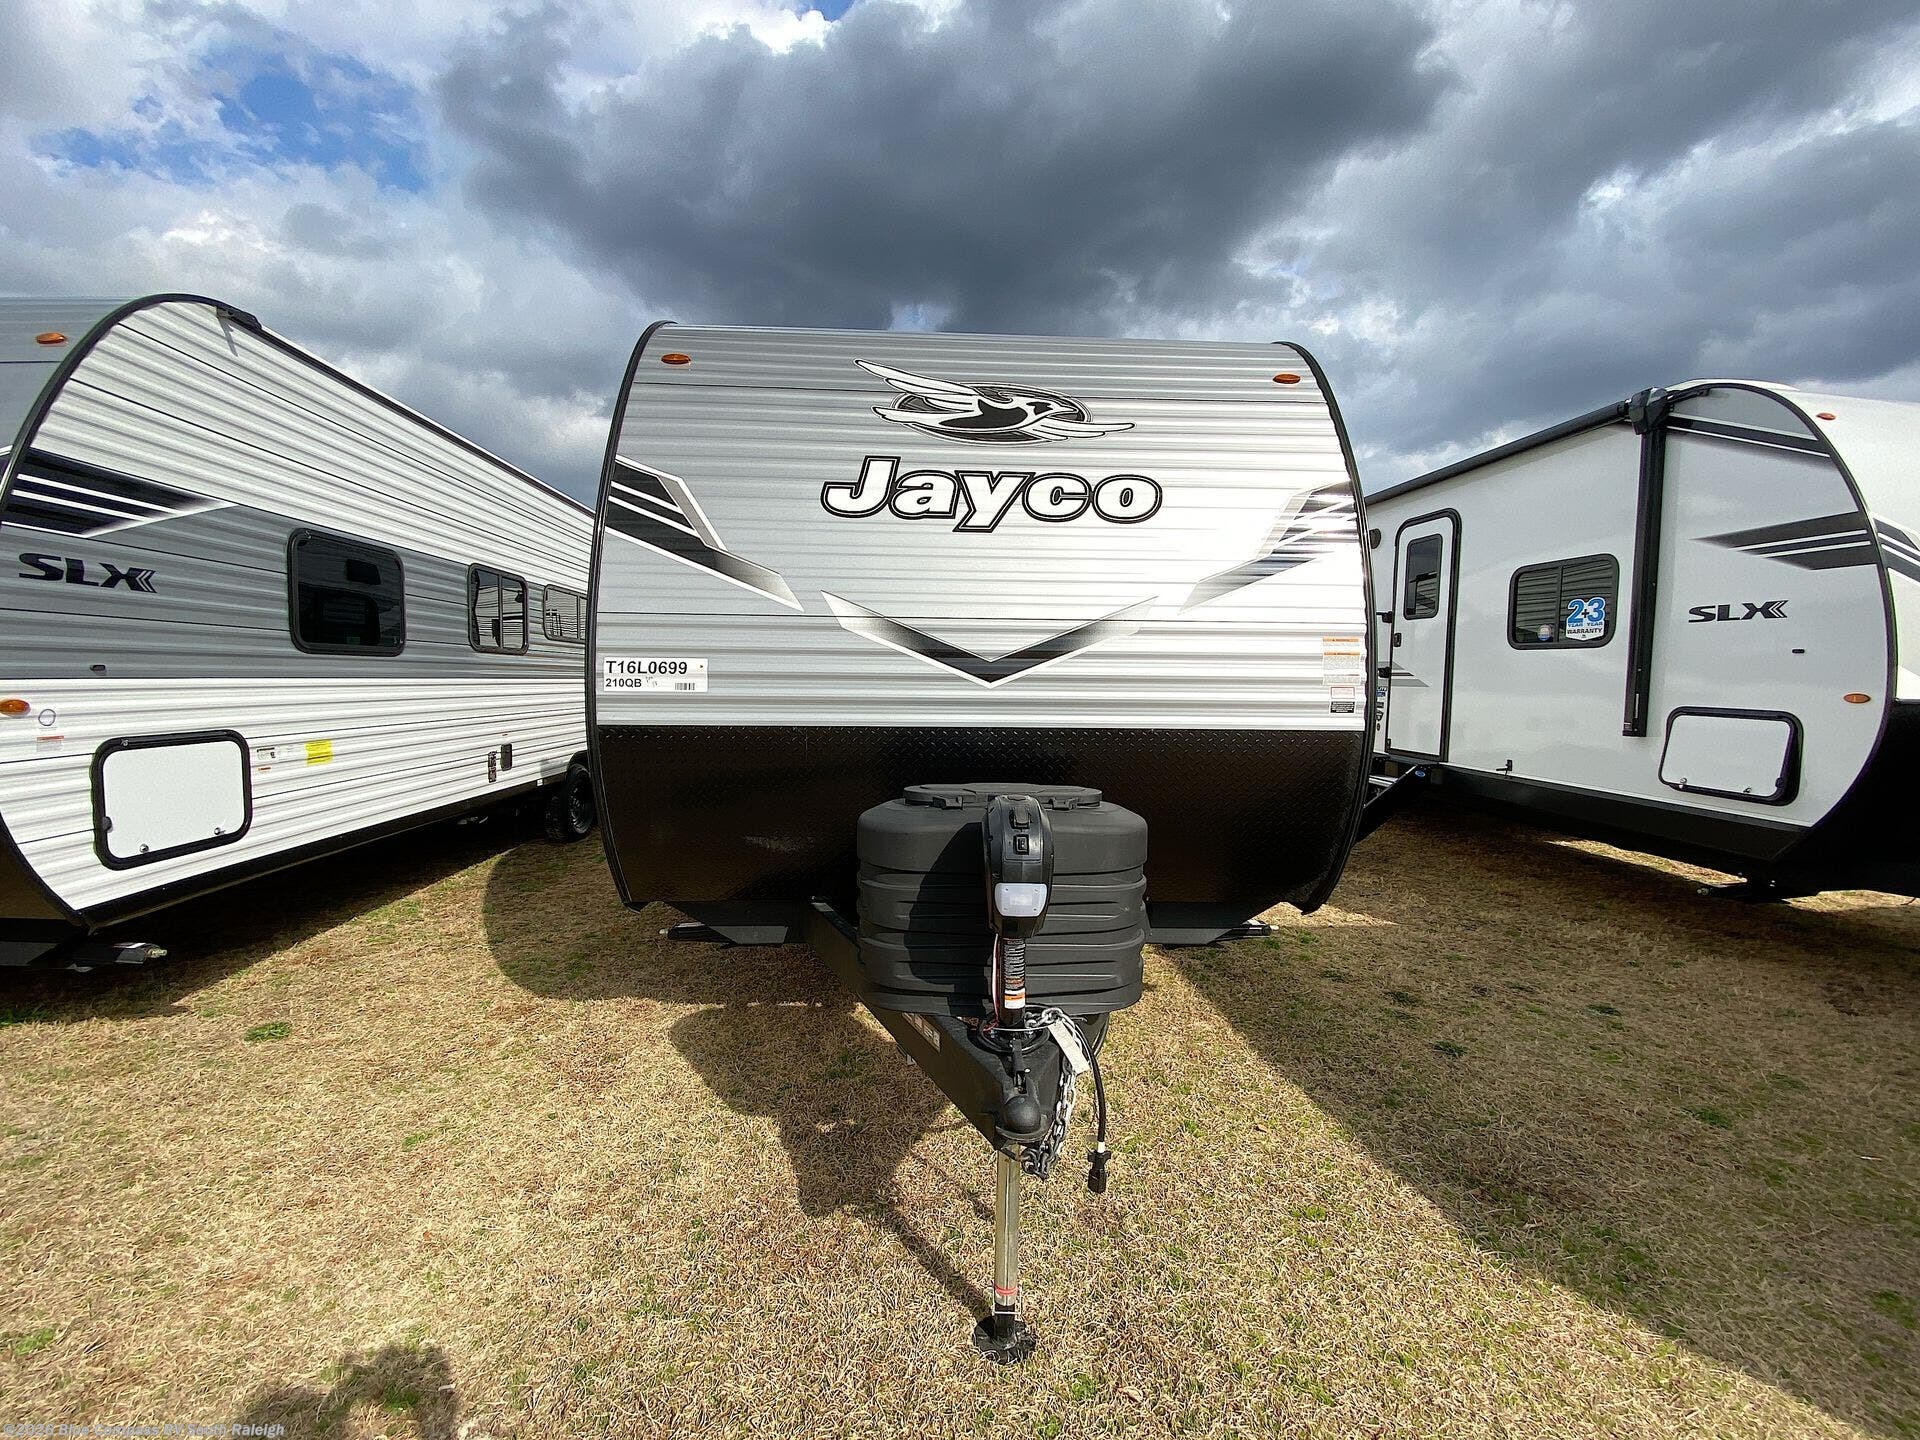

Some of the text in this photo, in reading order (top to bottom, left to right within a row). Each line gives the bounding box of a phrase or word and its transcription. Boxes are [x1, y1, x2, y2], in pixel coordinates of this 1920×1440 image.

[820, 455, 1163, 533] Jayco
[18, 552, 158, 594] SLX
[1688, 600, 1789, 623] SLX
[1566, 627, 1603, 635] WARRANTY
[605, 660, 688, 675] T16L0699
[605, 678, 642, 688] 210QB
